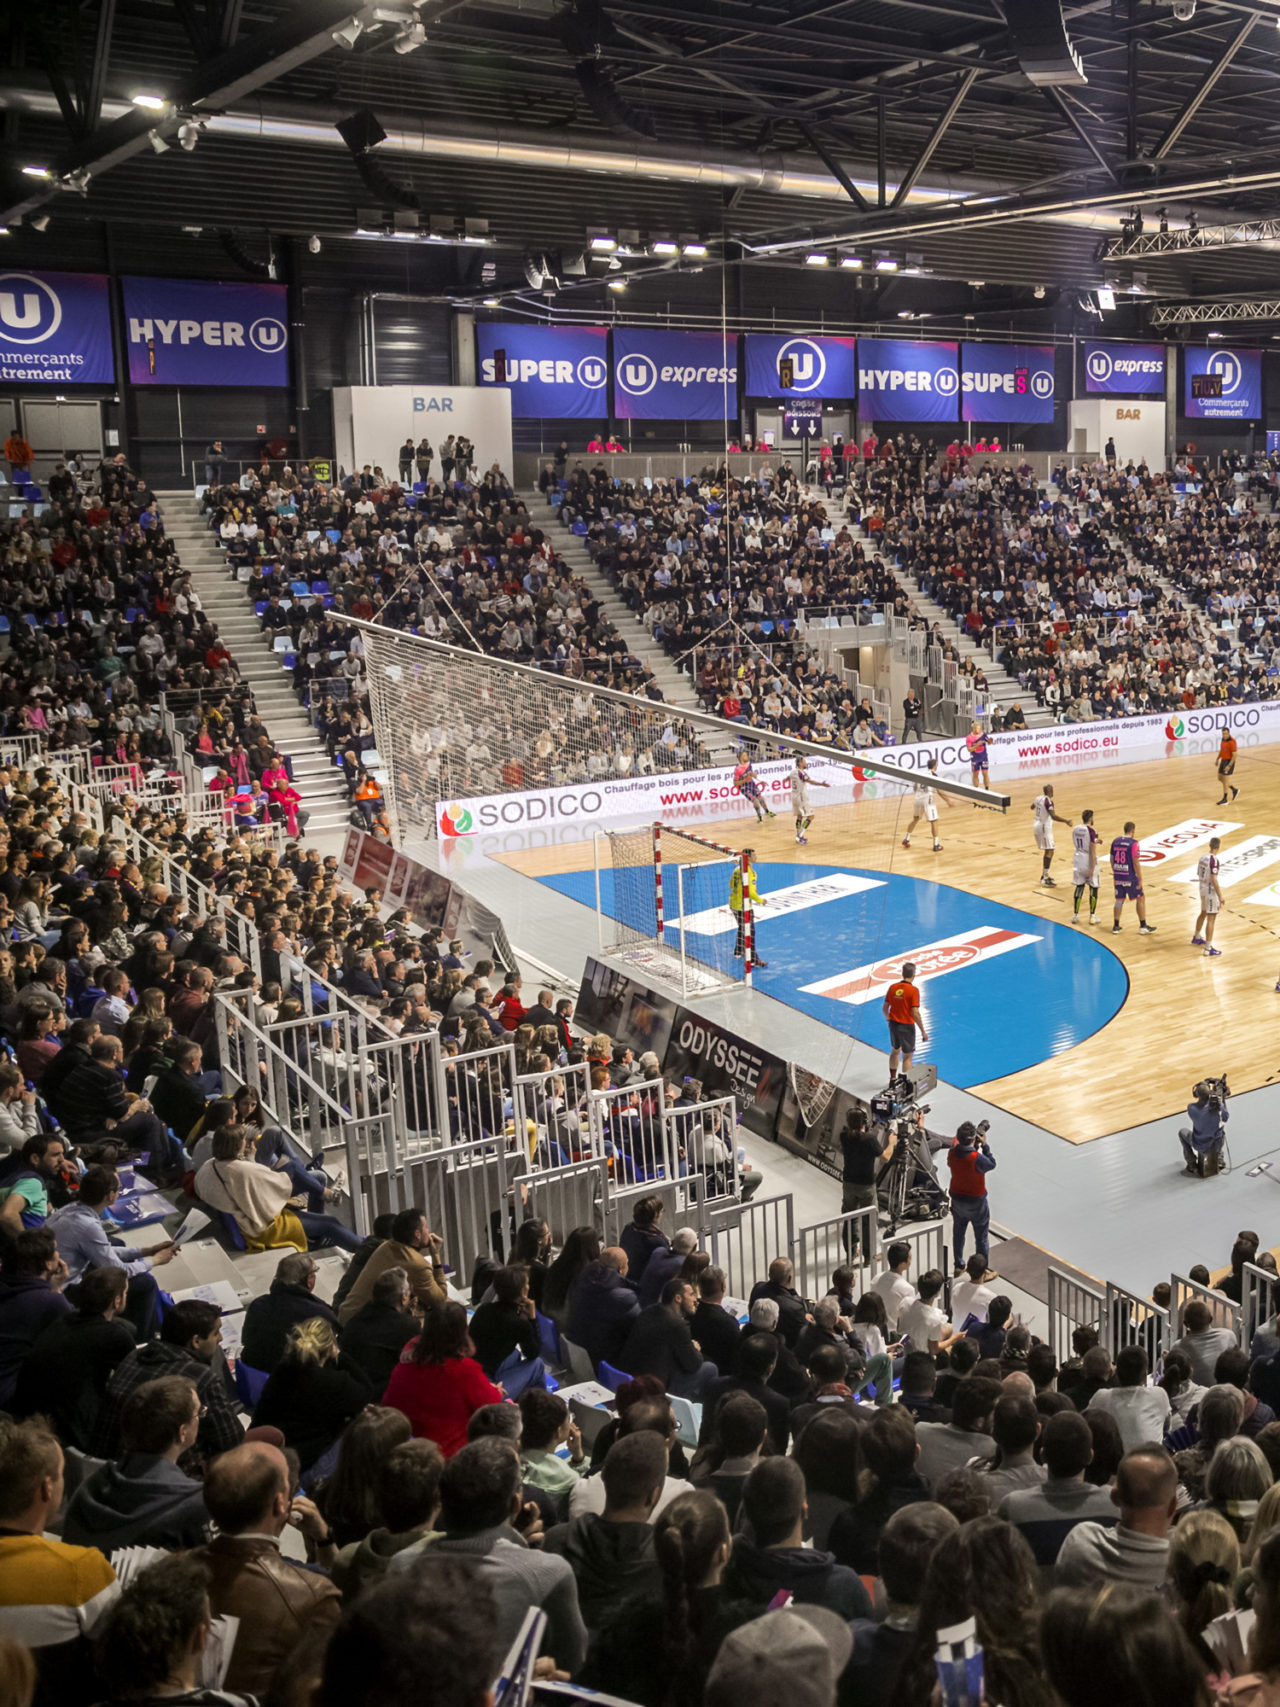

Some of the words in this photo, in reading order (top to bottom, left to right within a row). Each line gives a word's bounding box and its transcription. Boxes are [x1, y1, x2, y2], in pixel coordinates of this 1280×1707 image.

[130, 318, 245, 346] HYPER
[482, 358, 573, 383] SUPER
[660, 365, 737, 387] express
[1114, 358, 1163, 376] express
[859, 370, 931, 391] HYPER
[413, 397, 453, 412] BAR
[1198, 398, 1249, 408] Commerçants
[1204, 409, 1243, 417] autrement
[1116, 409, 1141, 420] BAR
[1018, 733, 1033, 742] bois
[1036, 732, 1051, 742] pour
[1054, 729, 1065, 737] les
[1067, 724, 1119, 737] professionnels
[1121, 721, 1145, 730] depuis
[1147, 718, 1163, 726] 1983
[1188, 710, 1260, 733] SODICO
[1018, 735, 1119, 757] www.sodico.eu
[604, 780, 656, 794] Chauffage
[658, 776, 680, 788] bois
[682, 774, 706, 787] pour
[708, 773, 722, 782] les
[660, 779, 791, 805] www.sodo.eu
[479, 791, 602, 826] SODICO
[1155, 823, 1226, 848] VEOLIA
[1115, 851, 1126, 864] 48
[680, 1020, 763, 1089] ODYSSEE
[730, 1078, 756, 1110] Design
